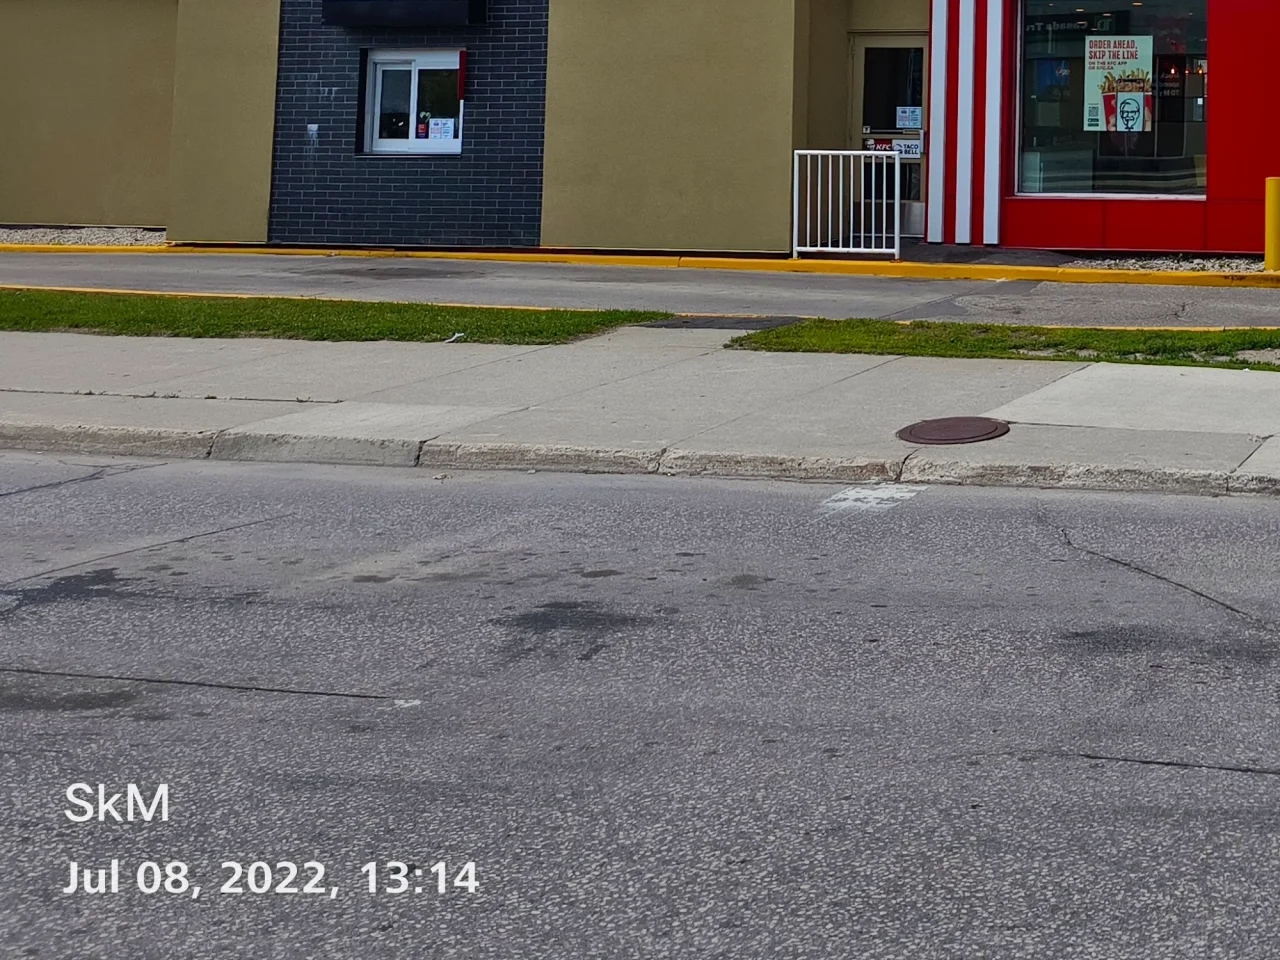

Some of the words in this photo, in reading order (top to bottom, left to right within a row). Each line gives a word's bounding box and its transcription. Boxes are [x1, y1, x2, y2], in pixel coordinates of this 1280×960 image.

[1088, 39, 1111, 49] ORDER
[1112, 39, 1138, 50] AHEAD,
[1088, 50, 1106, 60] SKIP
[1108, 50, 1121, 60] THE
[1122, 50, 1138, 60] LINE
